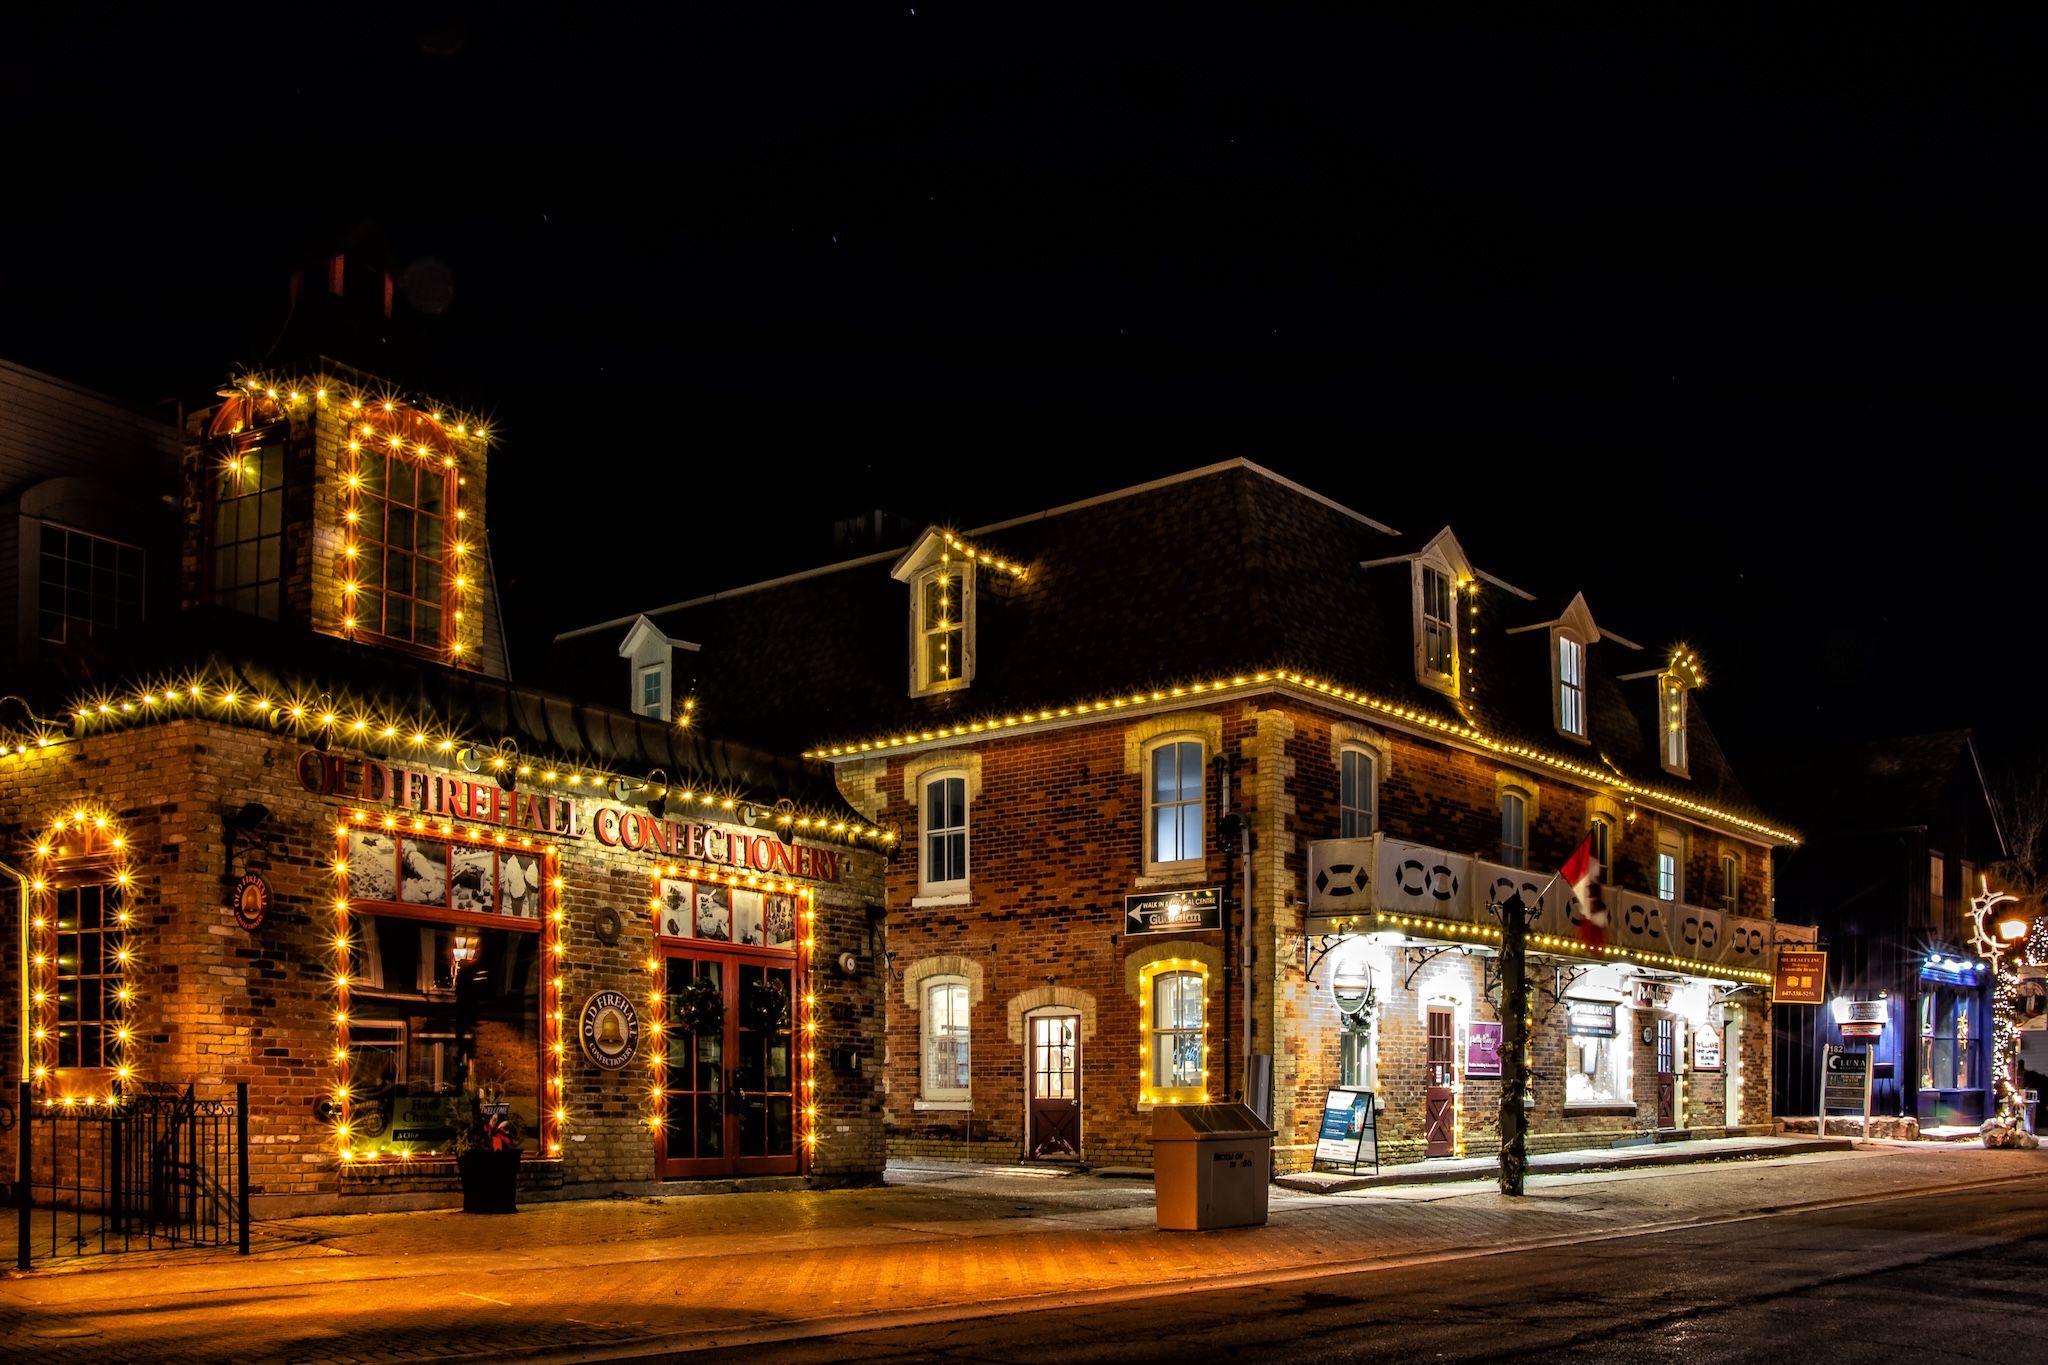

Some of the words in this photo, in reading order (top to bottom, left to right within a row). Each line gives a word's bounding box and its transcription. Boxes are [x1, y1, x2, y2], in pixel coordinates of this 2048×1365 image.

[296, 750, 393, 803] OLD
[398, 767, 587, 839] FIREHALL
[594, 807, 839, 881] CONFECTIONERY
[1143, 901, 1158, 909] WALK
[1195, 897, 1216, 906] CENTRE
[584, 1006, 598, 1037] OLD
[596, 994, 638, 1040] FIREHALL
[589, 1043, 633, 1066] CONFECTIONERY
[1829, 1045, 1844, 1053] 182
[1840, 1059, 1866, 1067] LUNA
[482, 1105, 509, 1115] WELCOME
